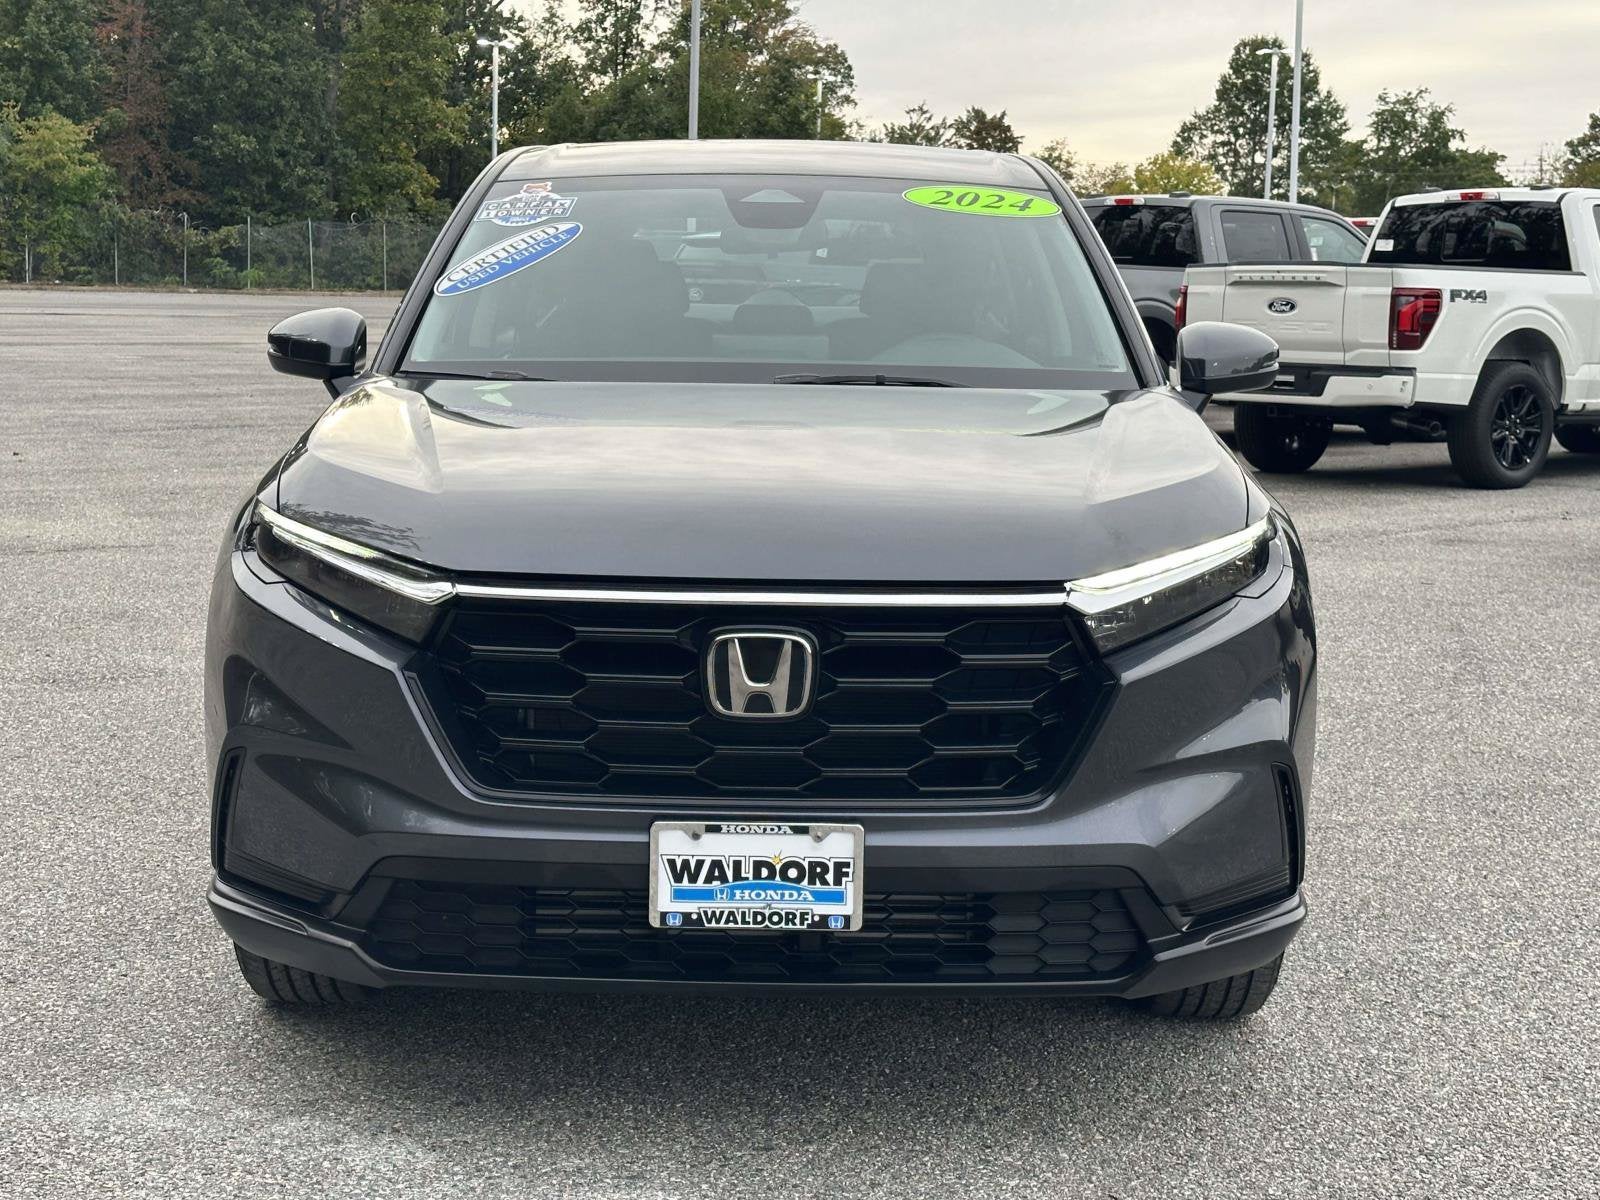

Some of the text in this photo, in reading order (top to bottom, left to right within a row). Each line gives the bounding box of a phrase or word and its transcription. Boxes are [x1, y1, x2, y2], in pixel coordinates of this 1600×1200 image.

[488, 199, 569, 210] CARFAX
[928, 190, 1035, 212] 2024
[497, 208, 564, 217] OWNER
[447, 226, 560, 283] CERTIFIED
[457, 232, 571, 290] USED VEHICLE
[1449, 288, 1488, 303] FX4
[1271, 300, 1293, 312] Ford
[720, 824, 794, 834] HONDA
[664, 857, 852, 888] WALDORF
[733, 889, 815, 902] HONDA
[702, 909, 812, 927] WALDORF
